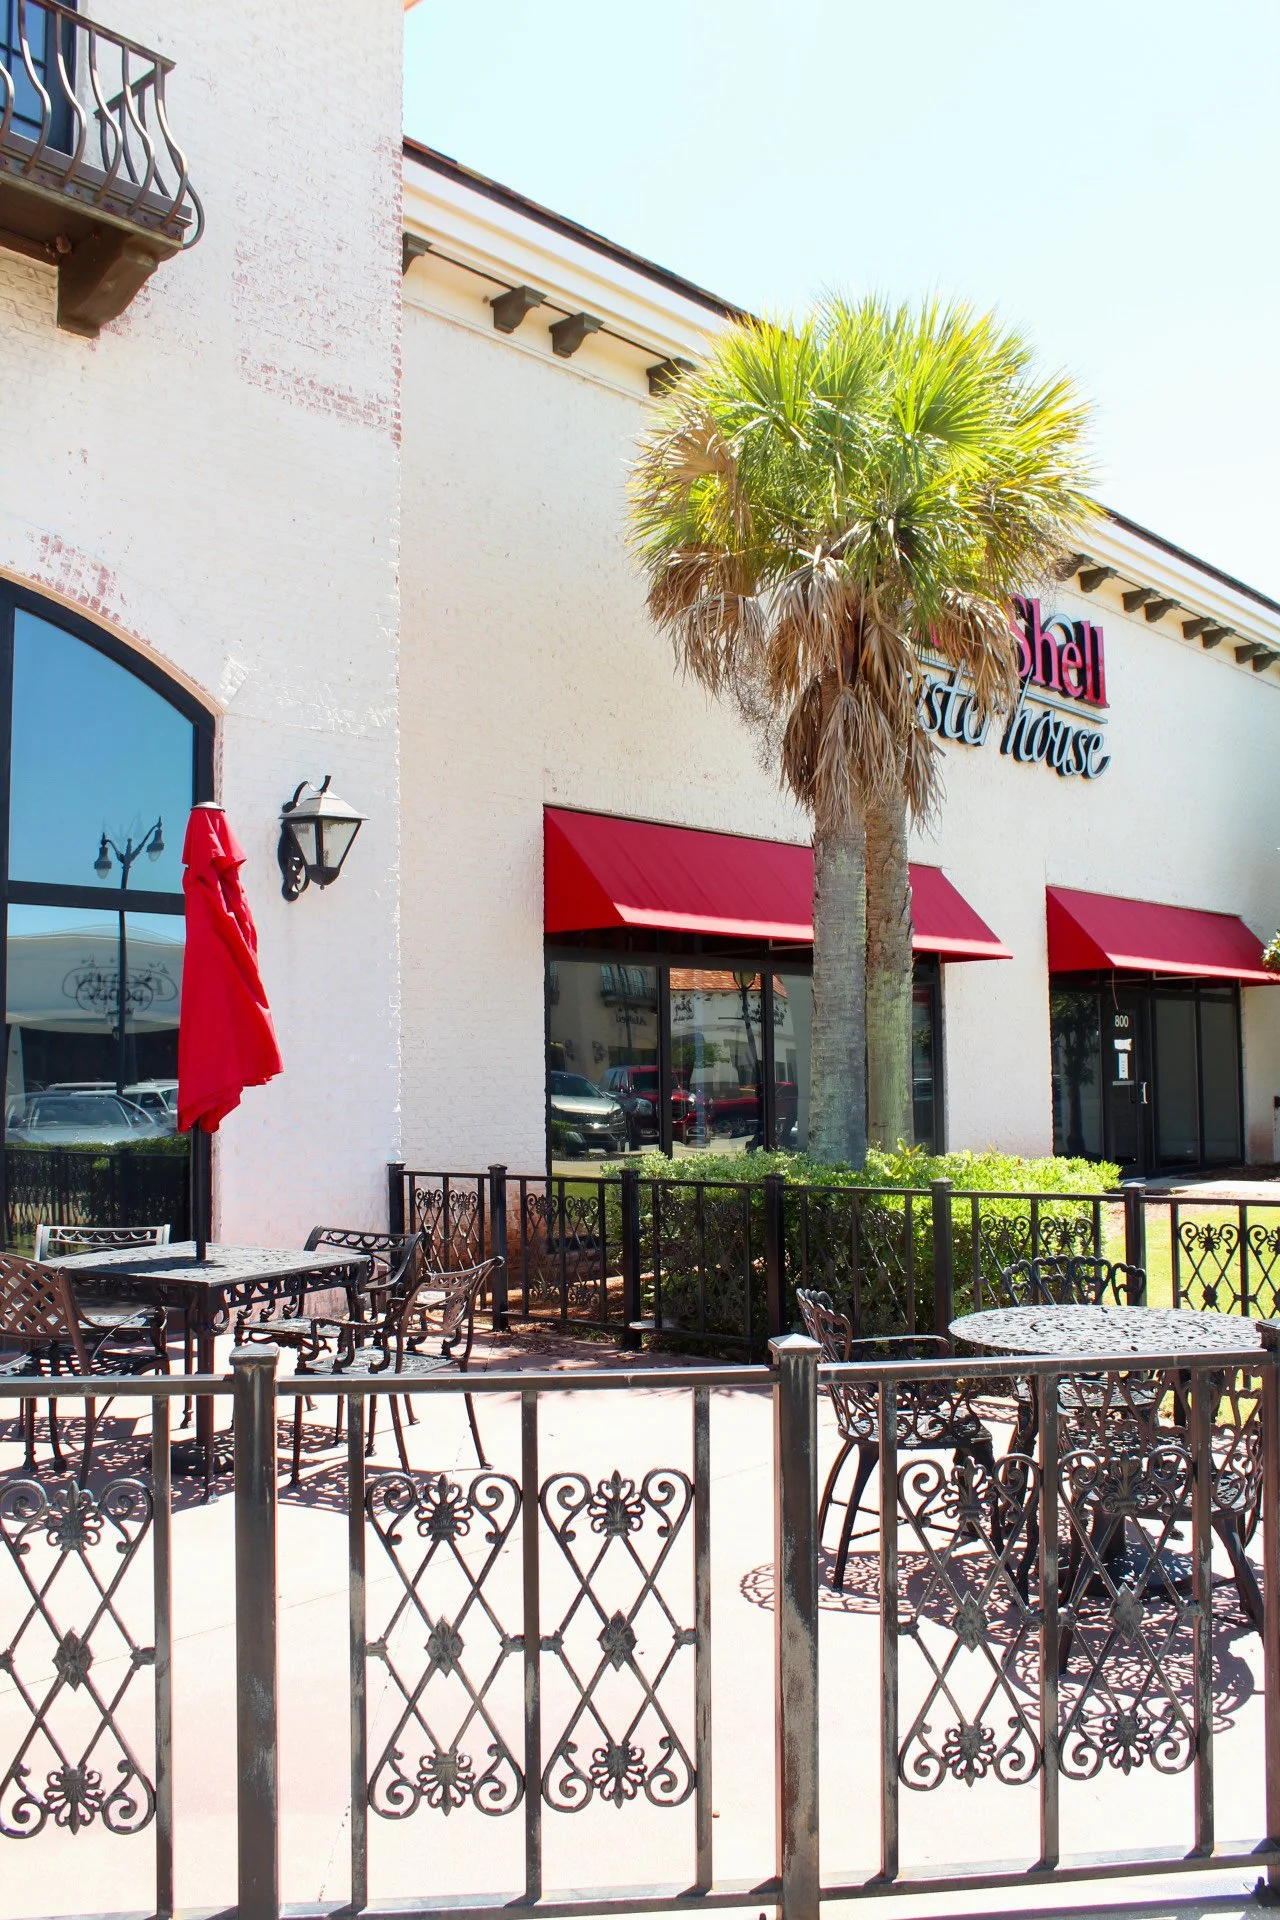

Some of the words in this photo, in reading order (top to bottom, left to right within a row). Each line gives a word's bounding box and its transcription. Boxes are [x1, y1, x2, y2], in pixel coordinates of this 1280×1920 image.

[1007, 592, 1109, 709] Shell
[1002, 665, 1111, 779] house
[1114, 1014, 1129, 1028] 800
